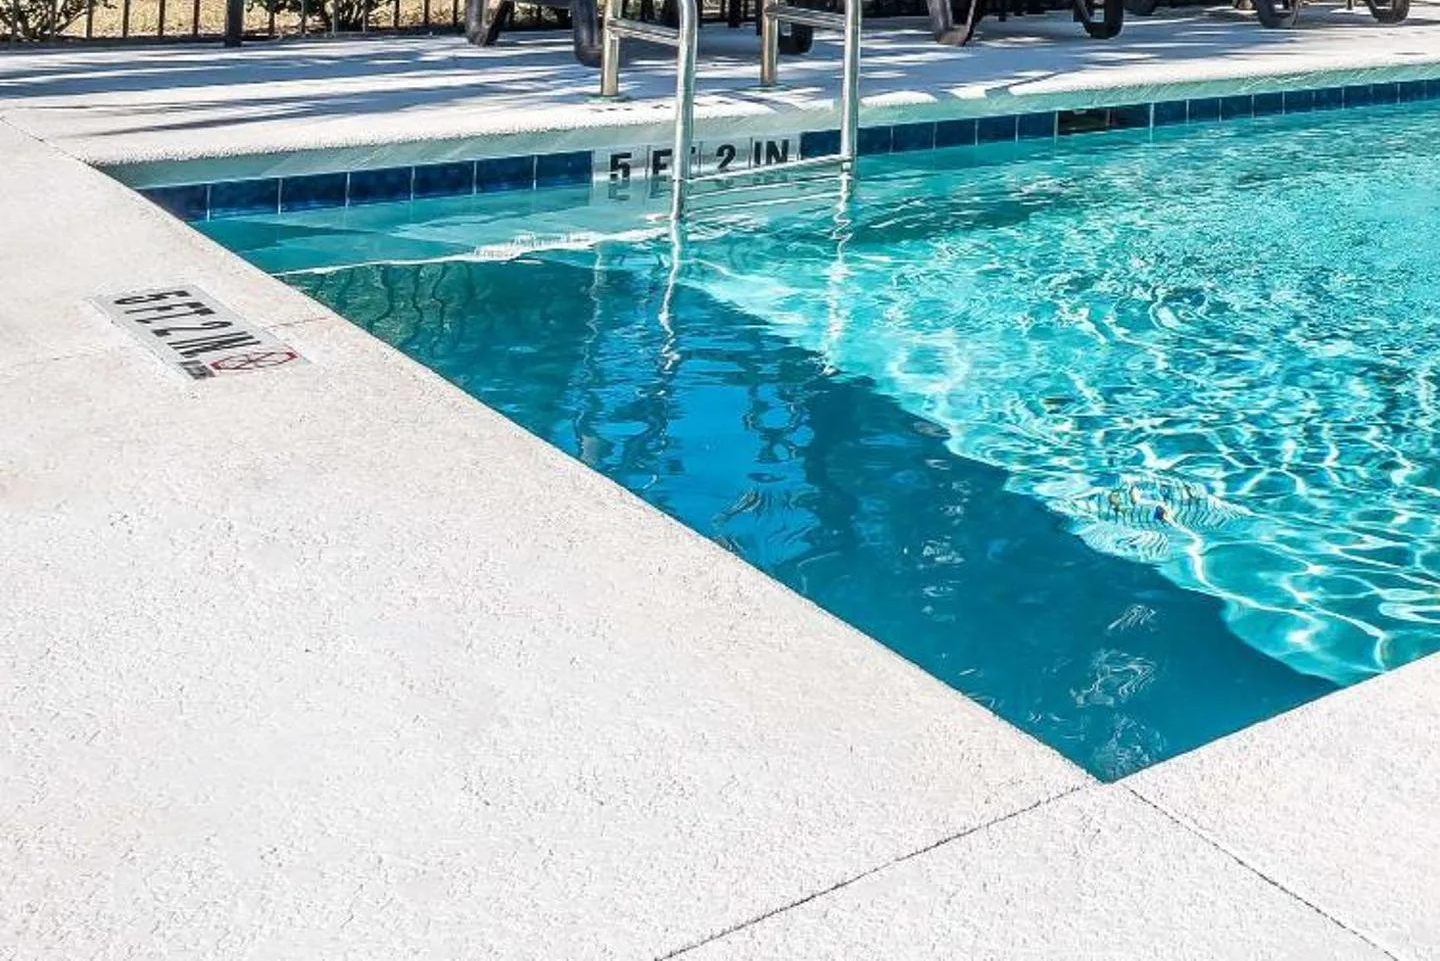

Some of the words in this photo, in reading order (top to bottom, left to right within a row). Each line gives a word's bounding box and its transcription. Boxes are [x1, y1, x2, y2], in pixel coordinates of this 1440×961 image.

[609, 151, 632, 179] 5
[715, 143, 736, 170] 2
[753, 138, 790, 168] IN
[113, 289, 193, 305] 5
[152, 320, 233, 337] 2
